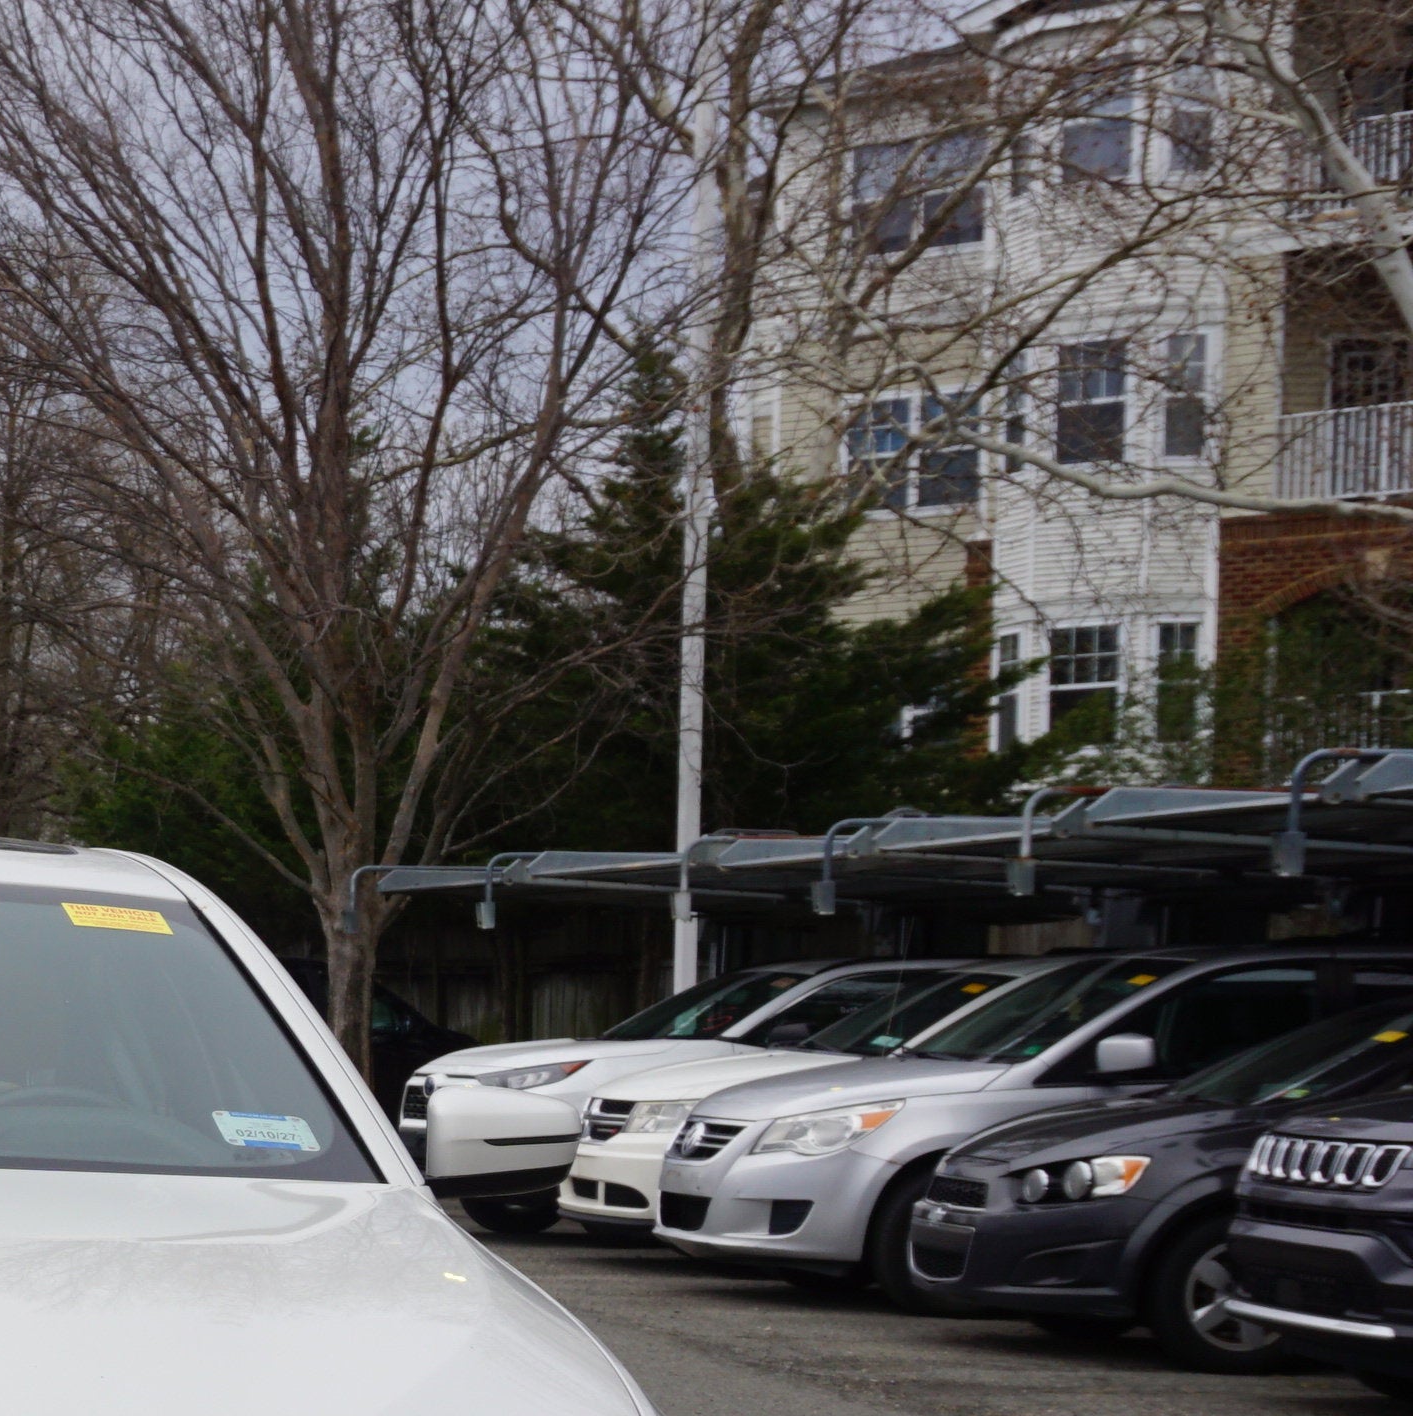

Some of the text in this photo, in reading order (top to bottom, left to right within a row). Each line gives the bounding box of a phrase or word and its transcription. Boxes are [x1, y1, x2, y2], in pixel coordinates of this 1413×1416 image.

[67, 904, 158, 918] THIS VEHICLE
[235, 1128, 296, 1141] 02/10/27
